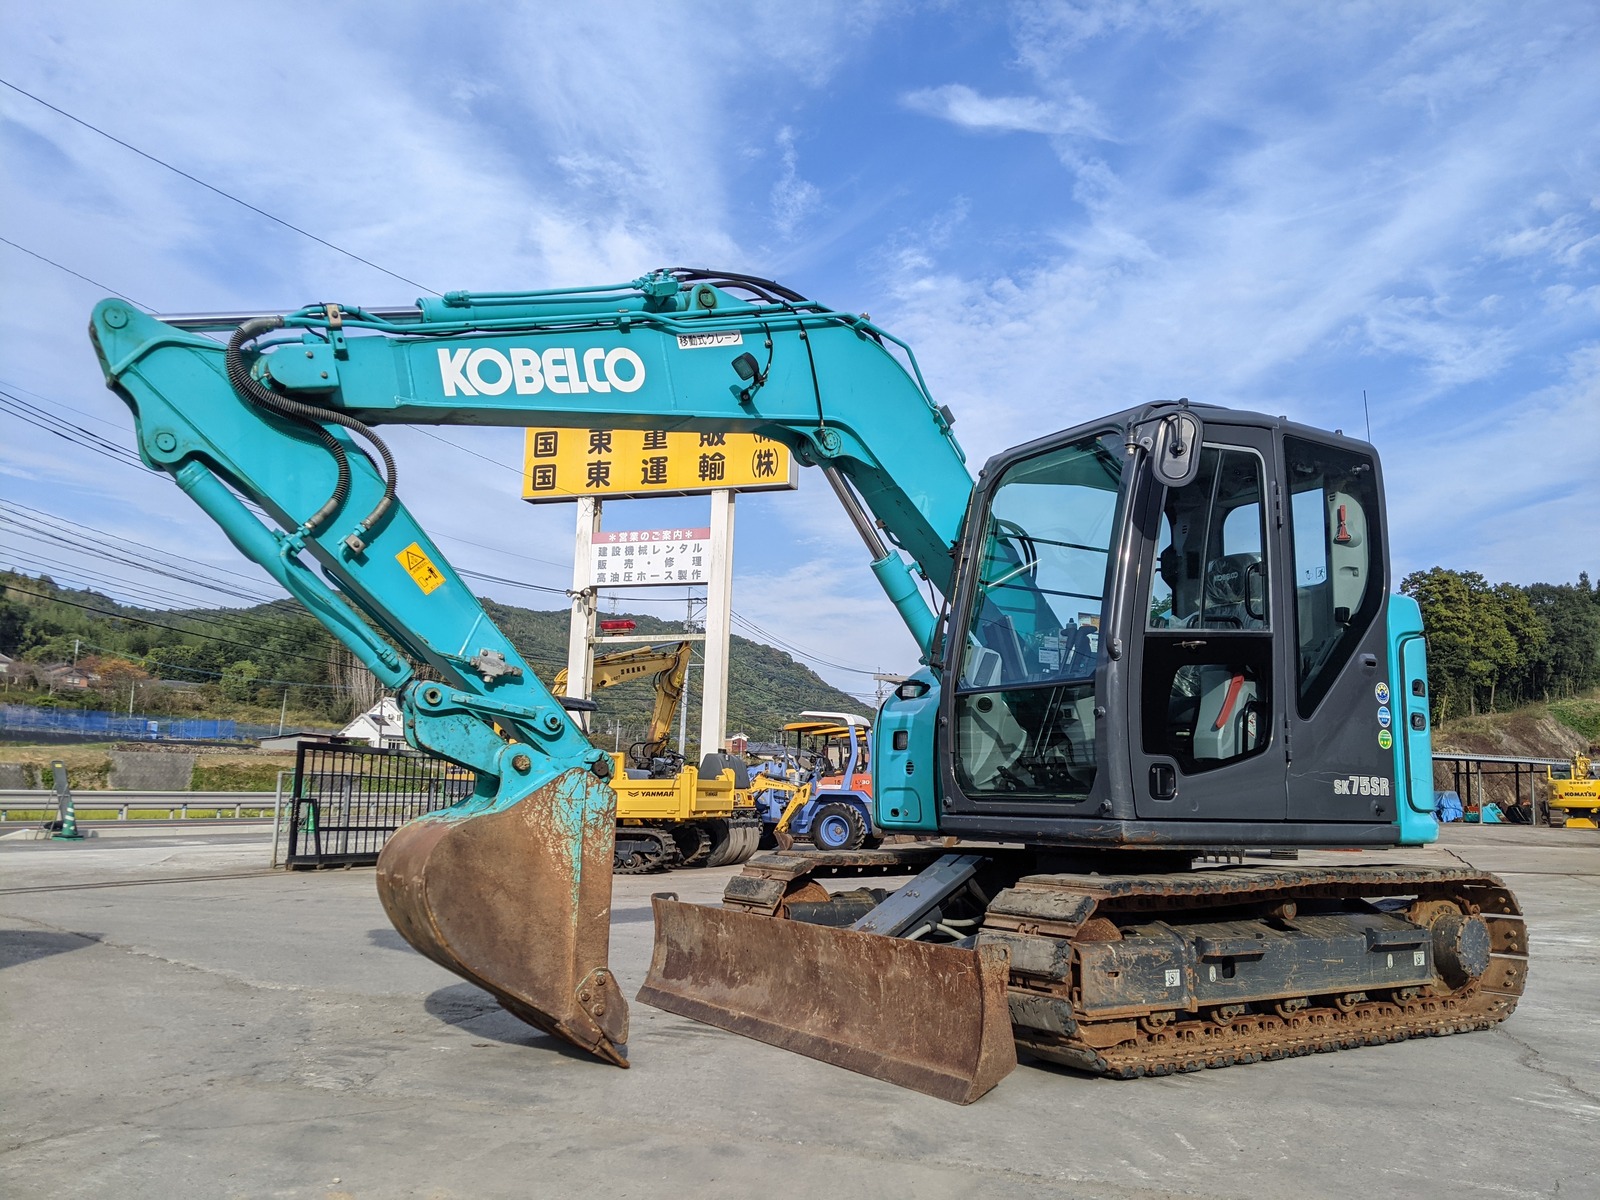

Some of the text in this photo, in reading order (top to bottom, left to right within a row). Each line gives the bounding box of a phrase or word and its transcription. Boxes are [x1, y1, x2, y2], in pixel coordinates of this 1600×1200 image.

[678, 332, 740, 347] 移動式クレーン
[437, 347, 646, 396] KOBELCO
[598, 543, 703, 557] 建設機械レンタル
[596, 569, 702, 583] 高油圧ホース製作
